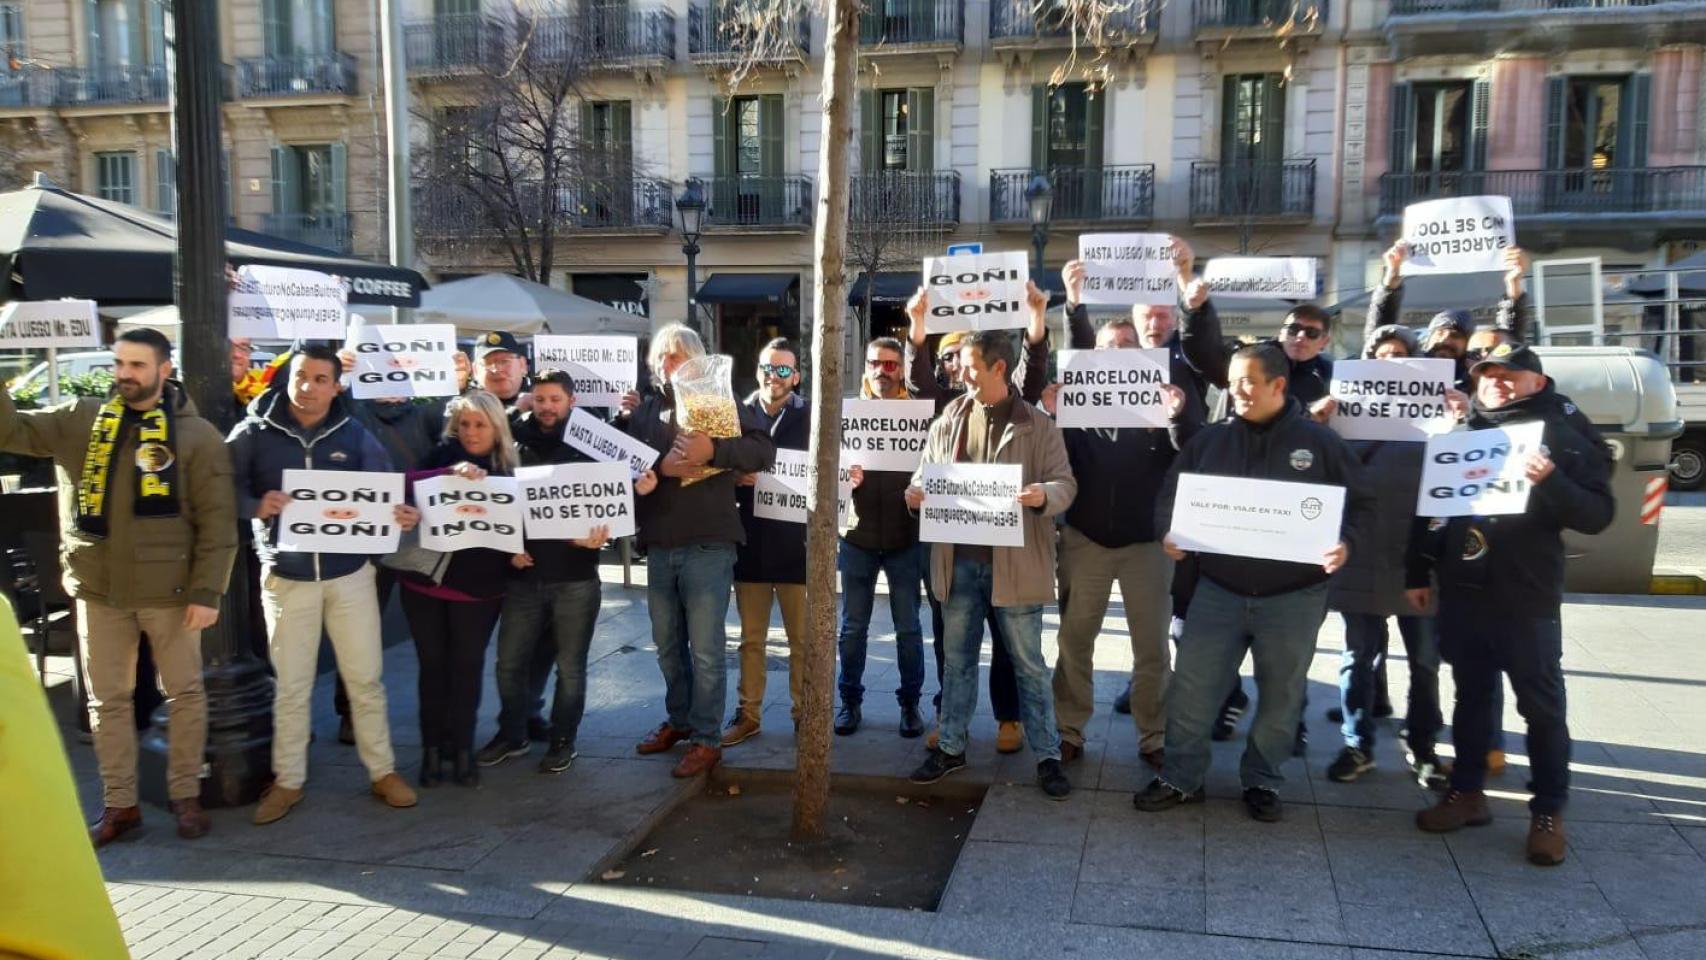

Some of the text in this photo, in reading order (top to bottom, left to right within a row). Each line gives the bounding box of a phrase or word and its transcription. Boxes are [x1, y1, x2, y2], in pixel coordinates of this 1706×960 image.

[1413, 219, 1450, 236] TOC
[1456, 218, 1475, 232] SE
[1085, 247, 1112, 260] HASTA
[1114, 247, 1142, 260] LUEGO
[930, 268, 1017, 285] GOÑI
[352, 277, 412, 298] COFFEE
[932, 300, 1019, 317] GOÑI
[20, 320, 51, 338] LUEGO
[70, 320, 90, 336] EDU
[356, 338, 445, 353] GOÑI
[540, 348, 634, 362] HASTA LUEGO Mr. EDU
[359, 368, 446, 383] GOÑI
[1064, 370, 1163, 385] BARCELONA
[574, 379, 602, 393] LUEGO
[1340, 381, 1446, 396] BARCELONA
[1064, 391, 1162, 406] NO SE TOCA
[1338, 402, 1445, 418] NO SE TOCA
[842, 418, 929, 432] BARCELONA
[570, 423, 593, 446] HASTA
[593, 435, 618, 458] LUEGO
[841, 437, 926, 451] NO SE TOCA
[291, 488, 390, 503] GOÑI
[526, 482, 627, 501] BARCELONA
[1429, 478, 1524, 499] GOÑI
[429, 490, 515, 506] GOÑI
[758, 490, 773, 505] EDU
[530, 502, 628, 520] NO SE TOCA
[1233, 505, 1256, 513] VIAJE
[1273, 508, 1291, 516] TAXI
[289, 521, 390, 536] GOÑI
[430, 520, 516, 537] GOÑI
